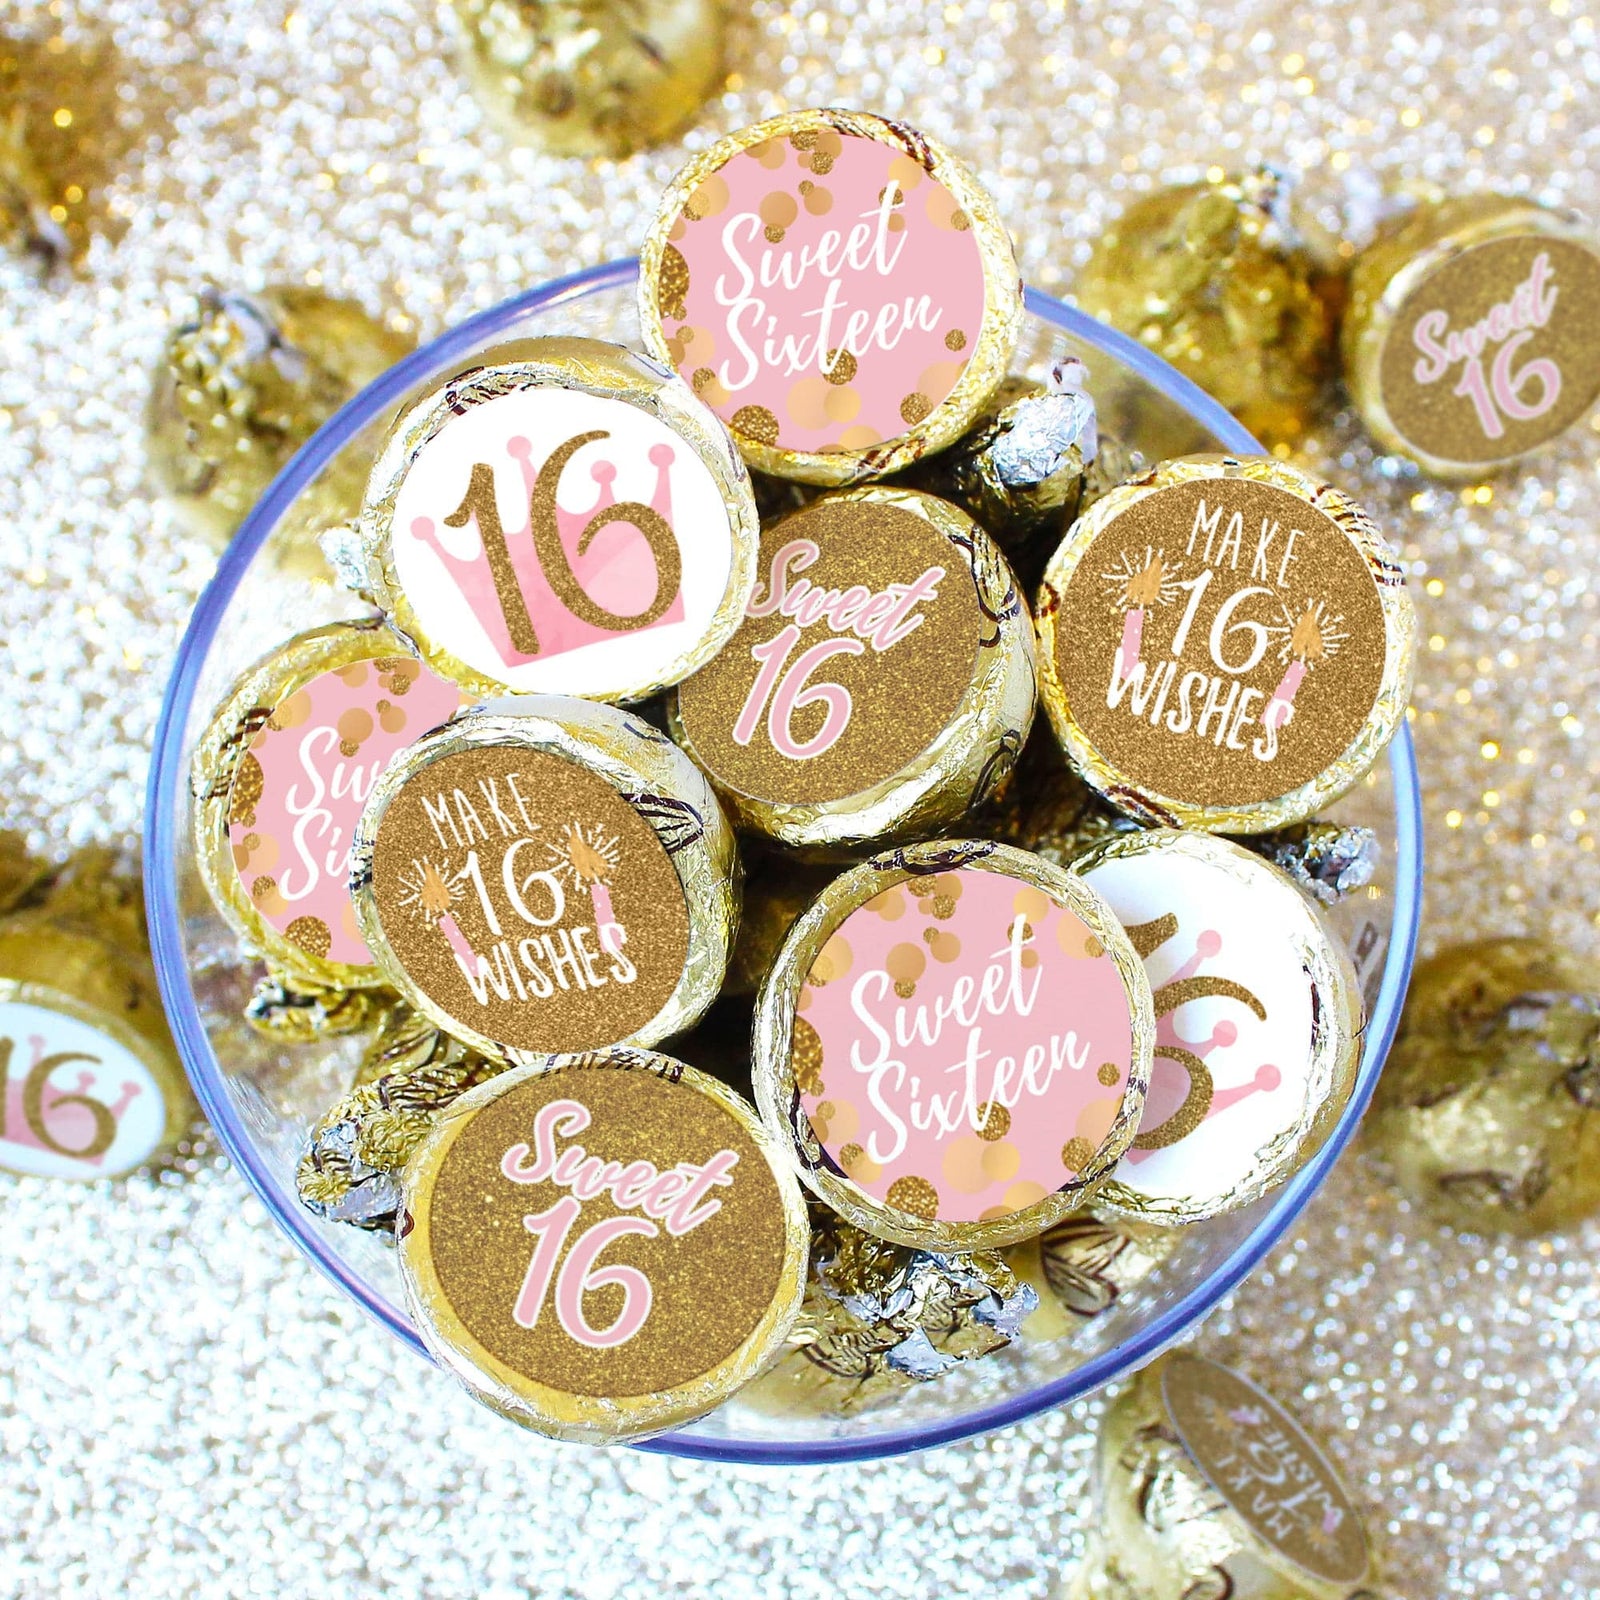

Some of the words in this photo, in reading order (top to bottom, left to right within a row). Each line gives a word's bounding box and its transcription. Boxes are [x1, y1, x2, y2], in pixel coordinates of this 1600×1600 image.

[714, 180, 908, 305] Sweet
[718, 279, 943, 391] Sixteen
[1413, 253, 1559, 384] Sweet
[1454, 330, 1562, 439] 16
[443, 429, 682, 655] 16
[745, 539, 947, 651] Sweet
[1186, 499, 1305, 588] MAKE
[1170, 569, 1276, 674] 16
[732, 624, 865, 760] 16
[1106, 647, 1296, 762] WISHES
[420, 773, 541, 849] MAKE
[455, 838, 566, 936] 16
[454, 922, 638, 1007] WISHES
[850, 913, 1043, 1073] Sweet
[866, 1027, 1091, 1165] Sixteen
[501, 1099, 740, 1237] Sweet
[512, 1196, 659, 1349] 16
